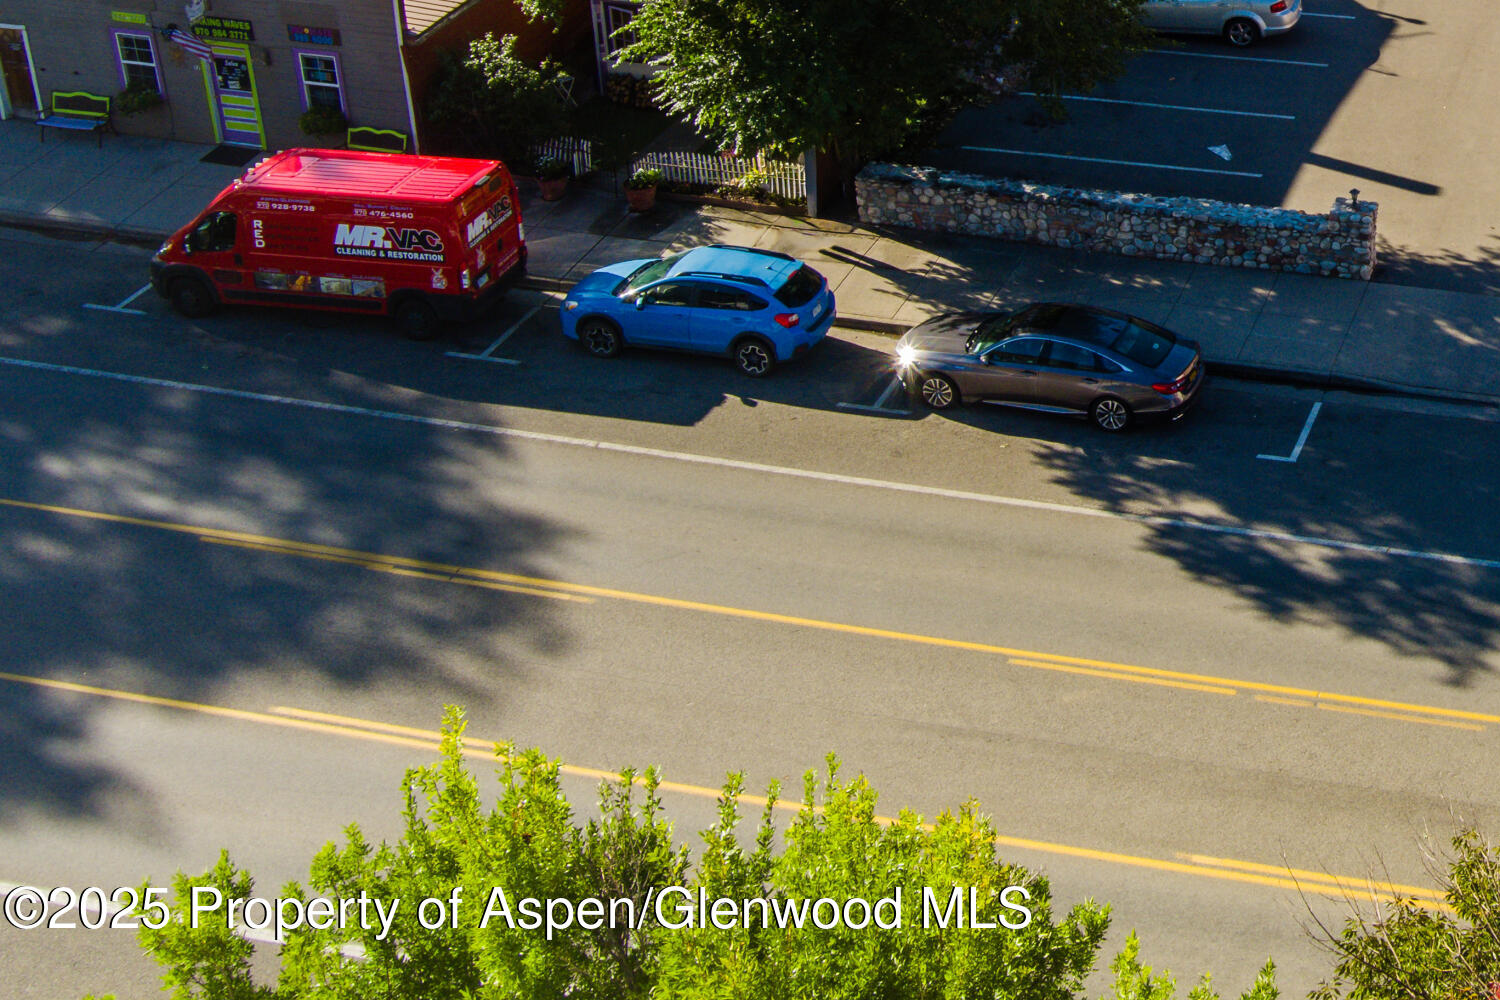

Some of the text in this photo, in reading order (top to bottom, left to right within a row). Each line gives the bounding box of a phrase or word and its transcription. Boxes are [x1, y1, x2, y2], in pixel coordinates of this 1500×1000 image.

[223, 19, 250, 31] WAVES
[336, 247, 377, 258] CLEANING
[387, 250, 445, 262] RESTORATION
